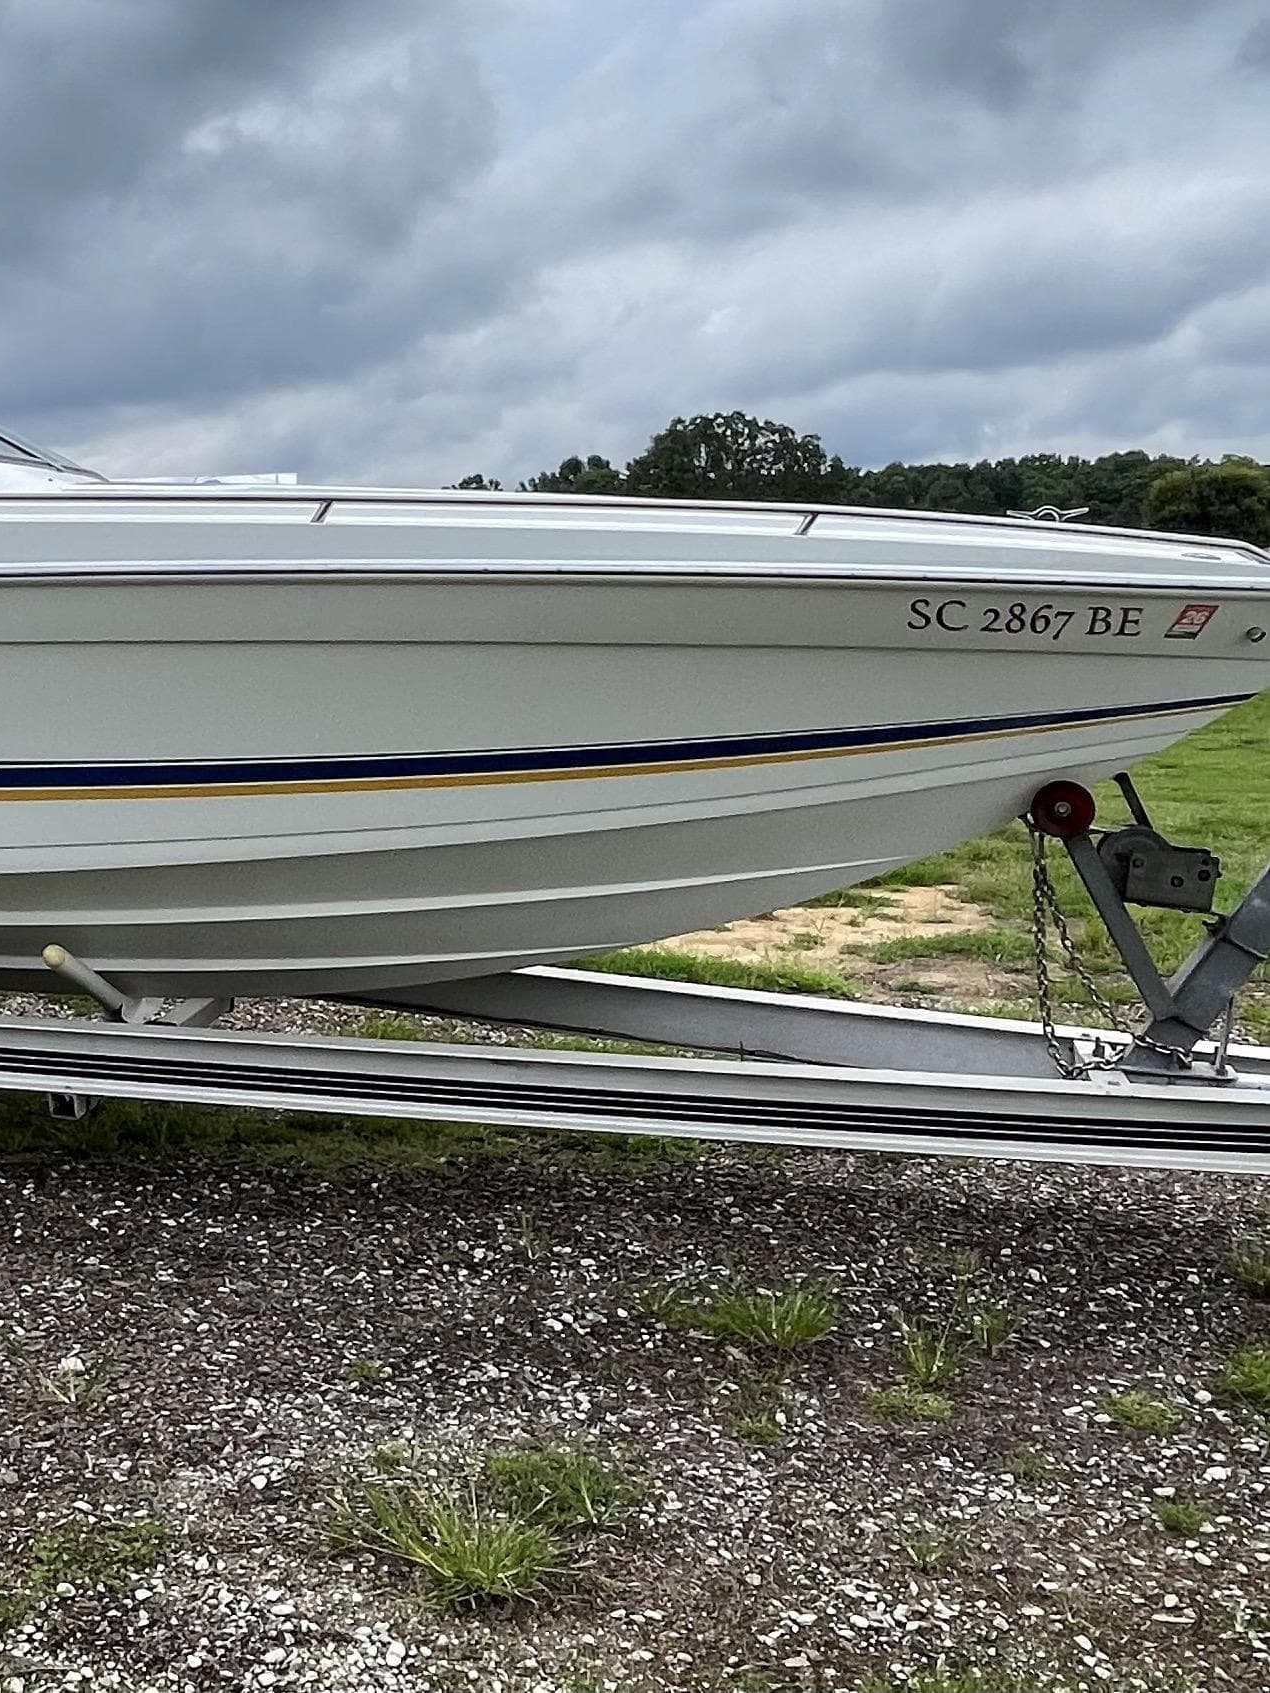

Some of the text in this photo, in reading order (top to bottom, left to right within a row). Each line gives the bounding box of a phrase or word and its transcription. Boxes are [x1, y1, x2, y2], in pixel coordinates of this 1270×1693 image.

[907, 598, 1144, 640] SC 2867 BE
